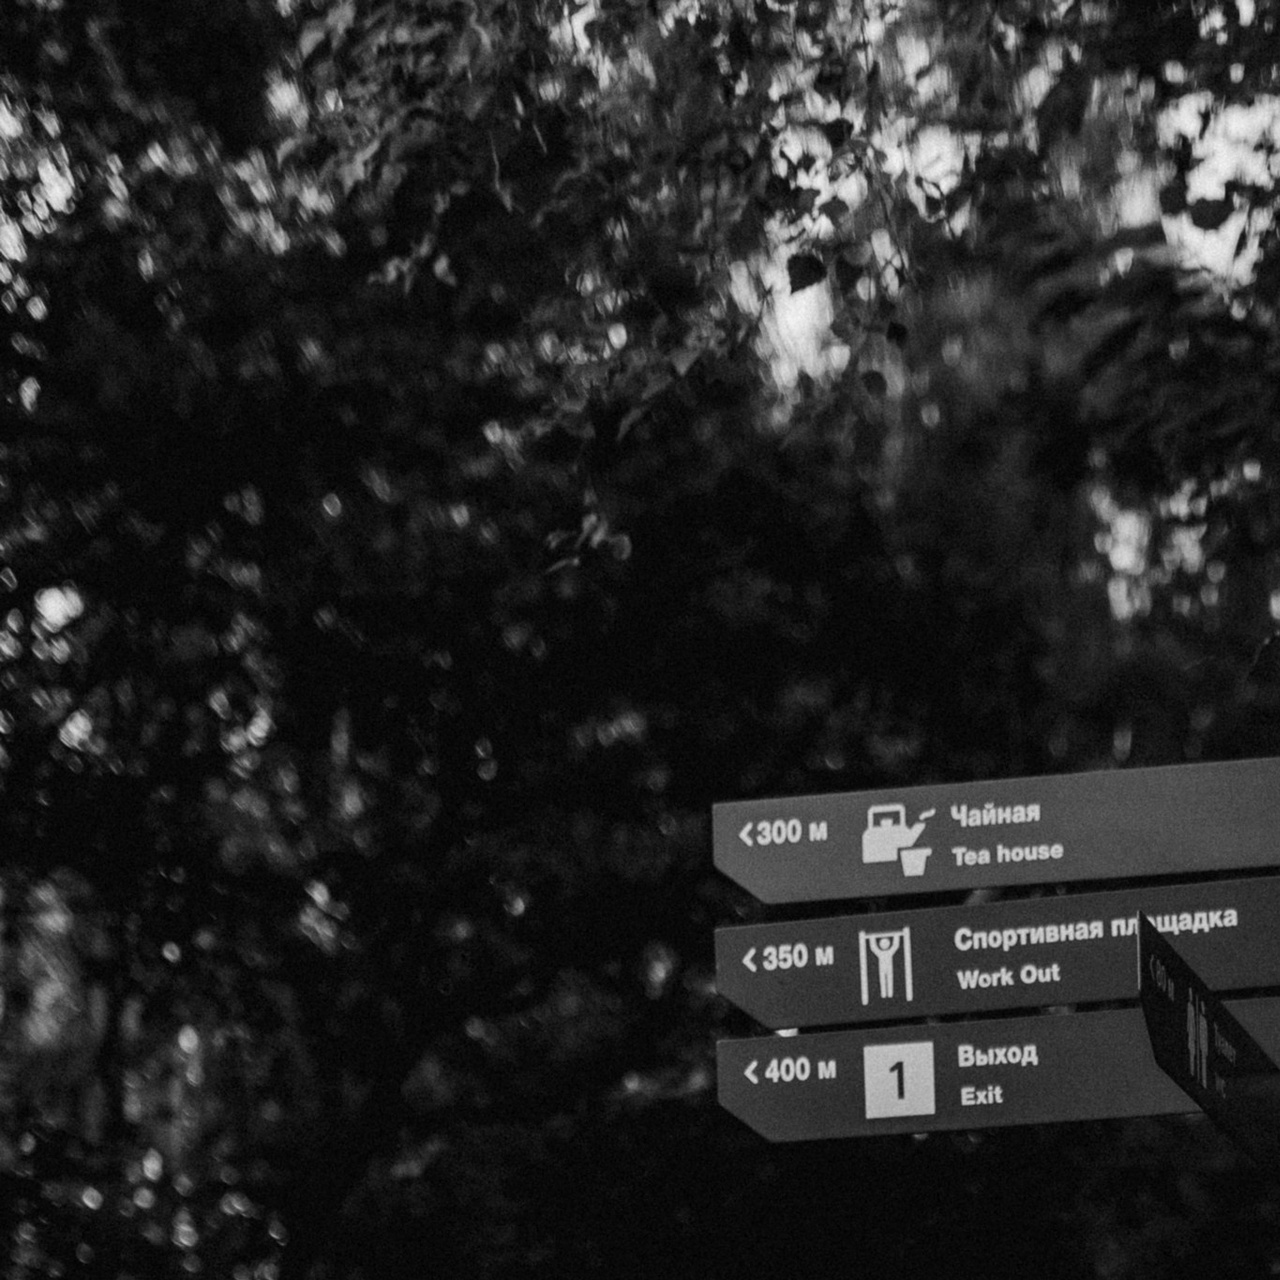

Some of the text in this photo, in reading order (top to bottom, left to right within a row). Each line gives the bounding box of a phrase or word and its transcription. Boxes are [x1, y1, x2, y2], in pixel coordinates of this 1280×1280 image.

[951, 803, 1040, 827] Чайная
[757, 819, 802, 845] 300
[952, 844, 1063, 866] Tea house
[955, 908, 1238, 951] Спортивная плщадка
[763, 943, 808, 970] 350
[957, 964, 1060, 989] Work Out
[958, 1045, 1038, 1067] Выход
[765, 1057, 810, 1082] 400
[889, 1061, 905, 1100] 1
[961, 1086, 1003, 1105] Exit
